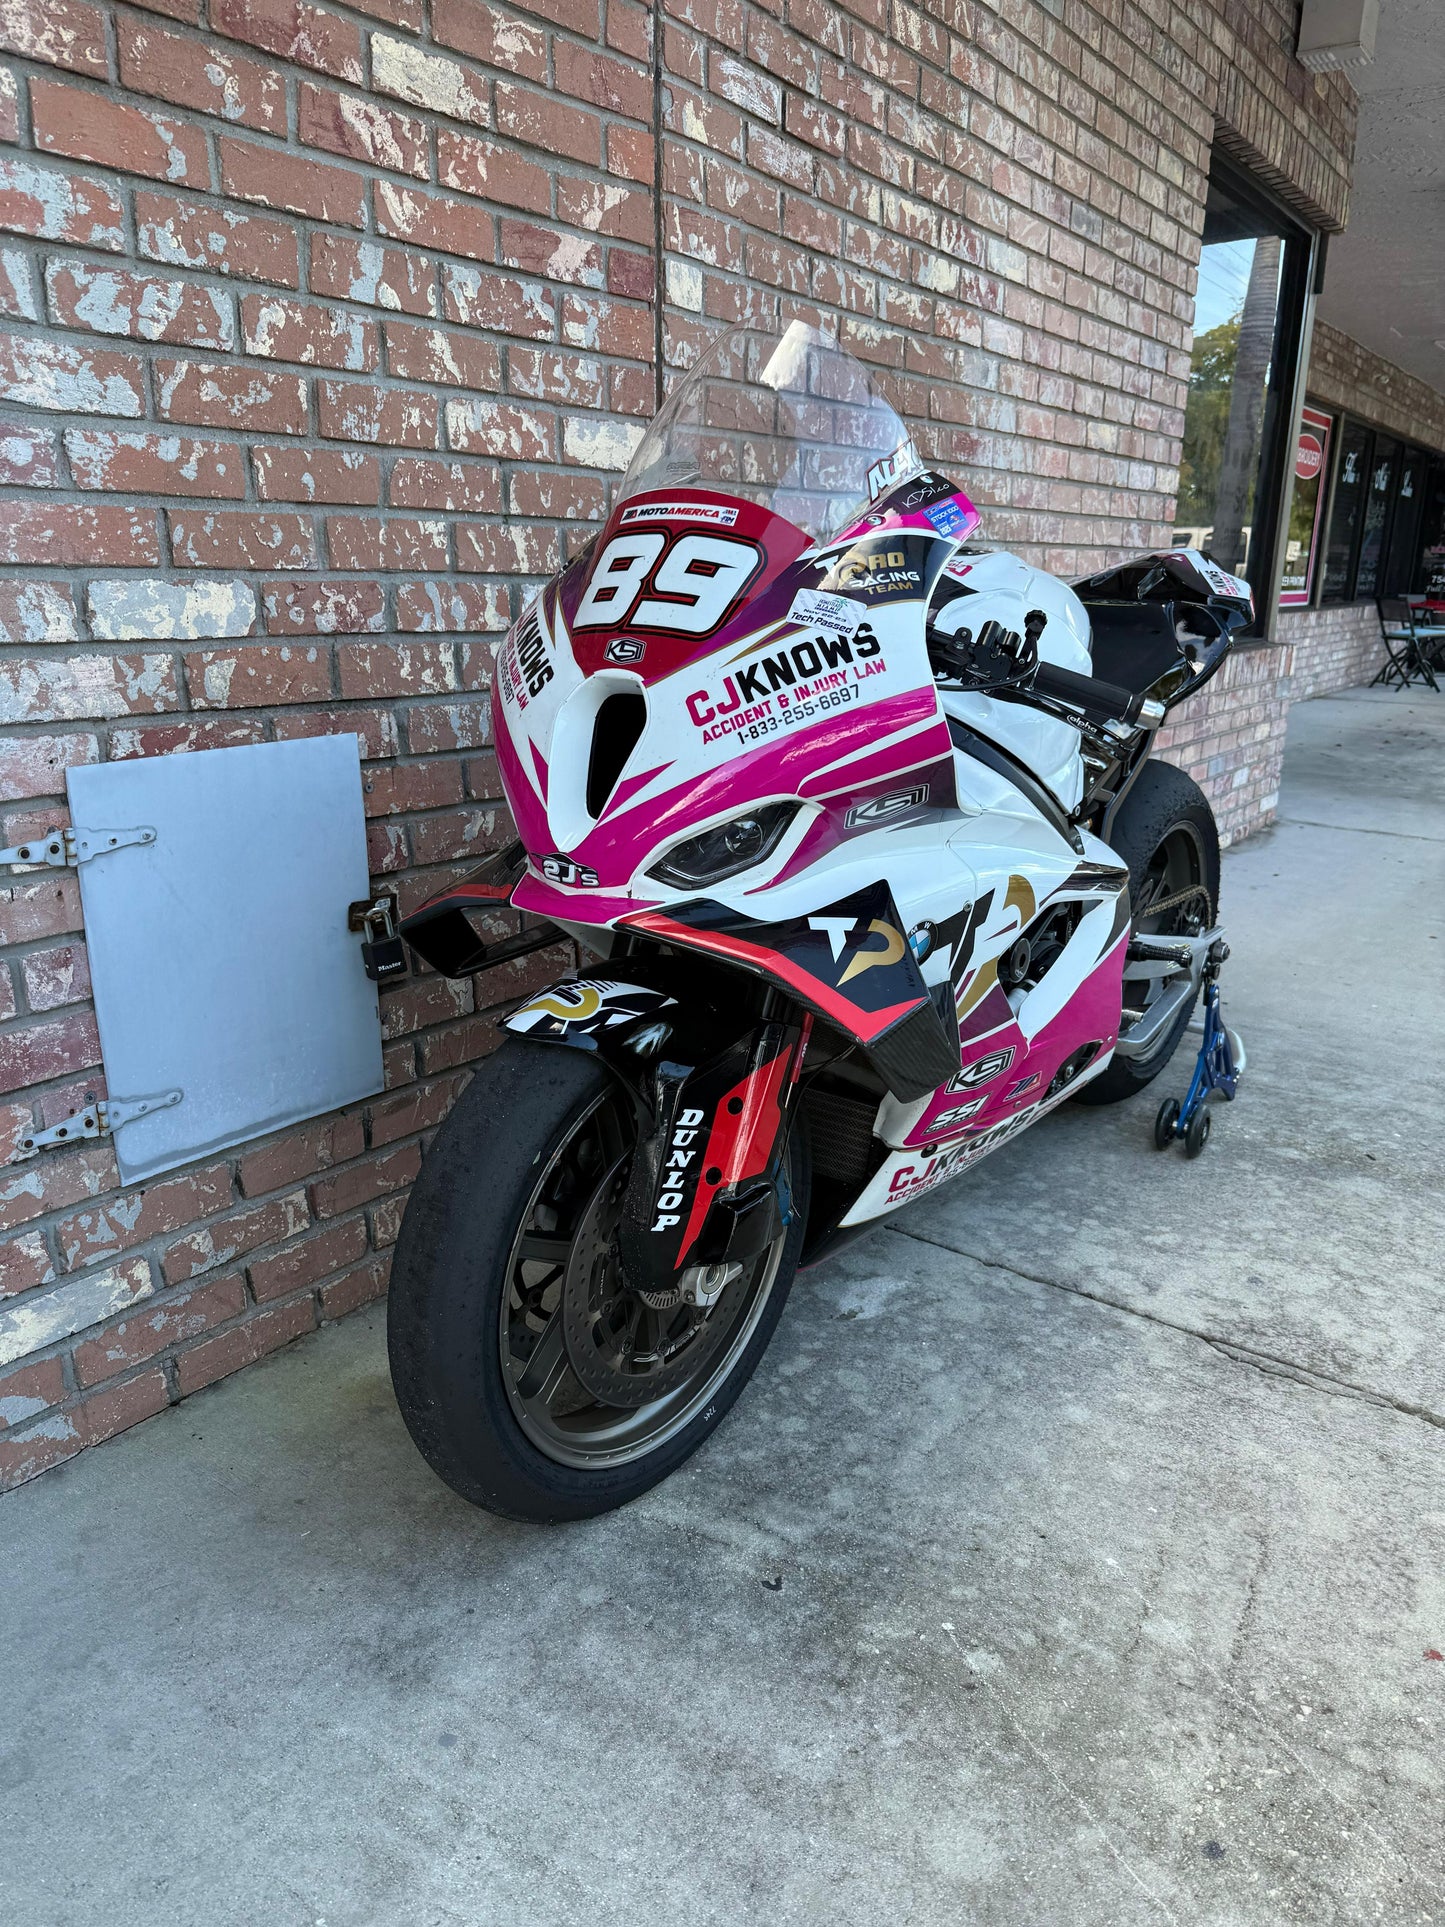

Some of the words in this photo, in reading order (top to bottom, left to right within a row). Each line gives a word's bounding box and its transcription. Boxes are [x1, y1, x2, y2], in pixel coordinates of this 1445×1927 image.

[638, 507, 720, 519] MOTOAMERICA
[572, 530, 763, 635] 89
[848, 571, 920, 588] RACING
[864, 581, 914, 595] TEAM
[791, 611, 814, 624] Tech
[814, 616, 854, 634] Passed
[515, 604, 555, 698] JKNOWS
[703, 700, 773, 745] ACCIDENT
[777, 693, 790, 709] &
[793, 669, 849, 702] INJURY
[853, 658, 887, 680] LAW
[737, 683, 861, 745] 1-833-255-6697
[1069, 715, 1098, 734] alpha
[377, 961, 402, 972] Master
[650, 1108, 704, 1232] DUNLOP
[884, 1173, 941, 1205] ACCIDENT
